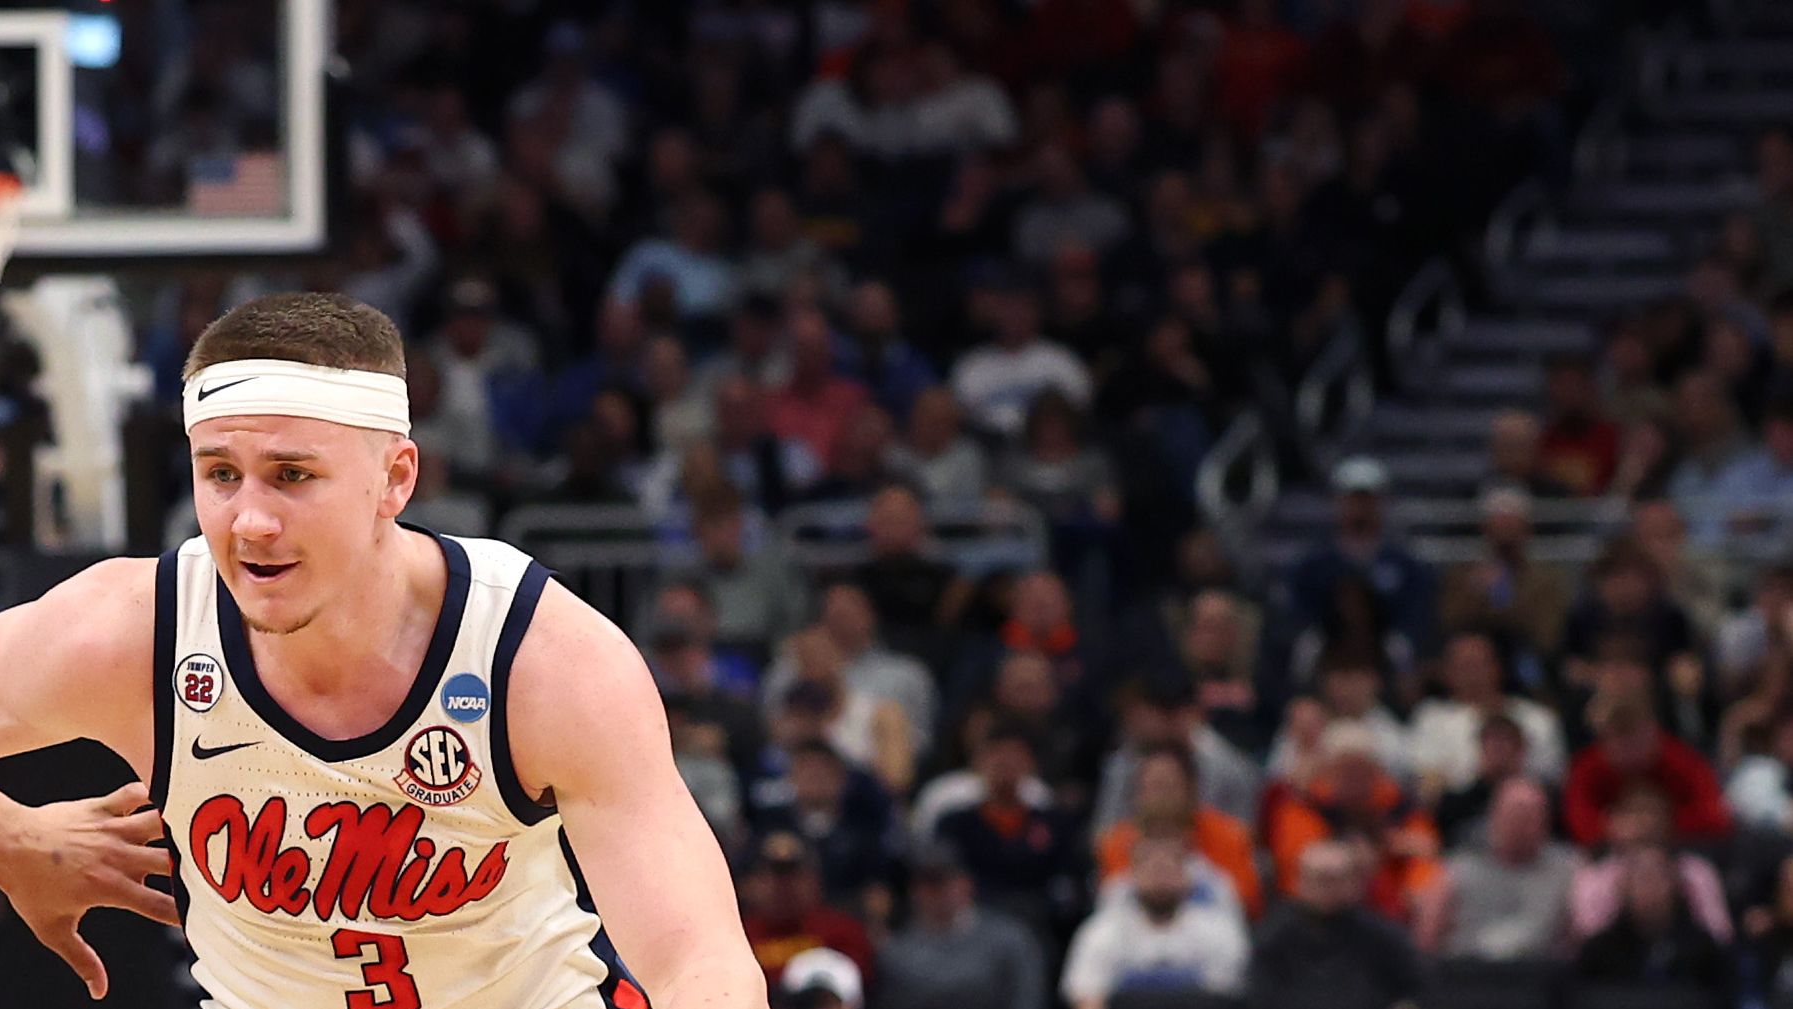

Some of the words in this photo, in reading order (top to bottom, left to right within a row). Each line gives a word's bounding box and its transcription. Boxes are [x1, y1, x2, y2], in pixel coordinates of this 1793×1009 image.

[186, 661, 215, 673] JUMPER
[184, 673, 214, 704] 22
[447, 696, 487, 710] NCAA
[409, 729, 466, 787] SEC
[405, 780, 474, 804] GRADUATE
[189, 793, 311, 917] Ole
[305, 801, 510, 922] Miss
